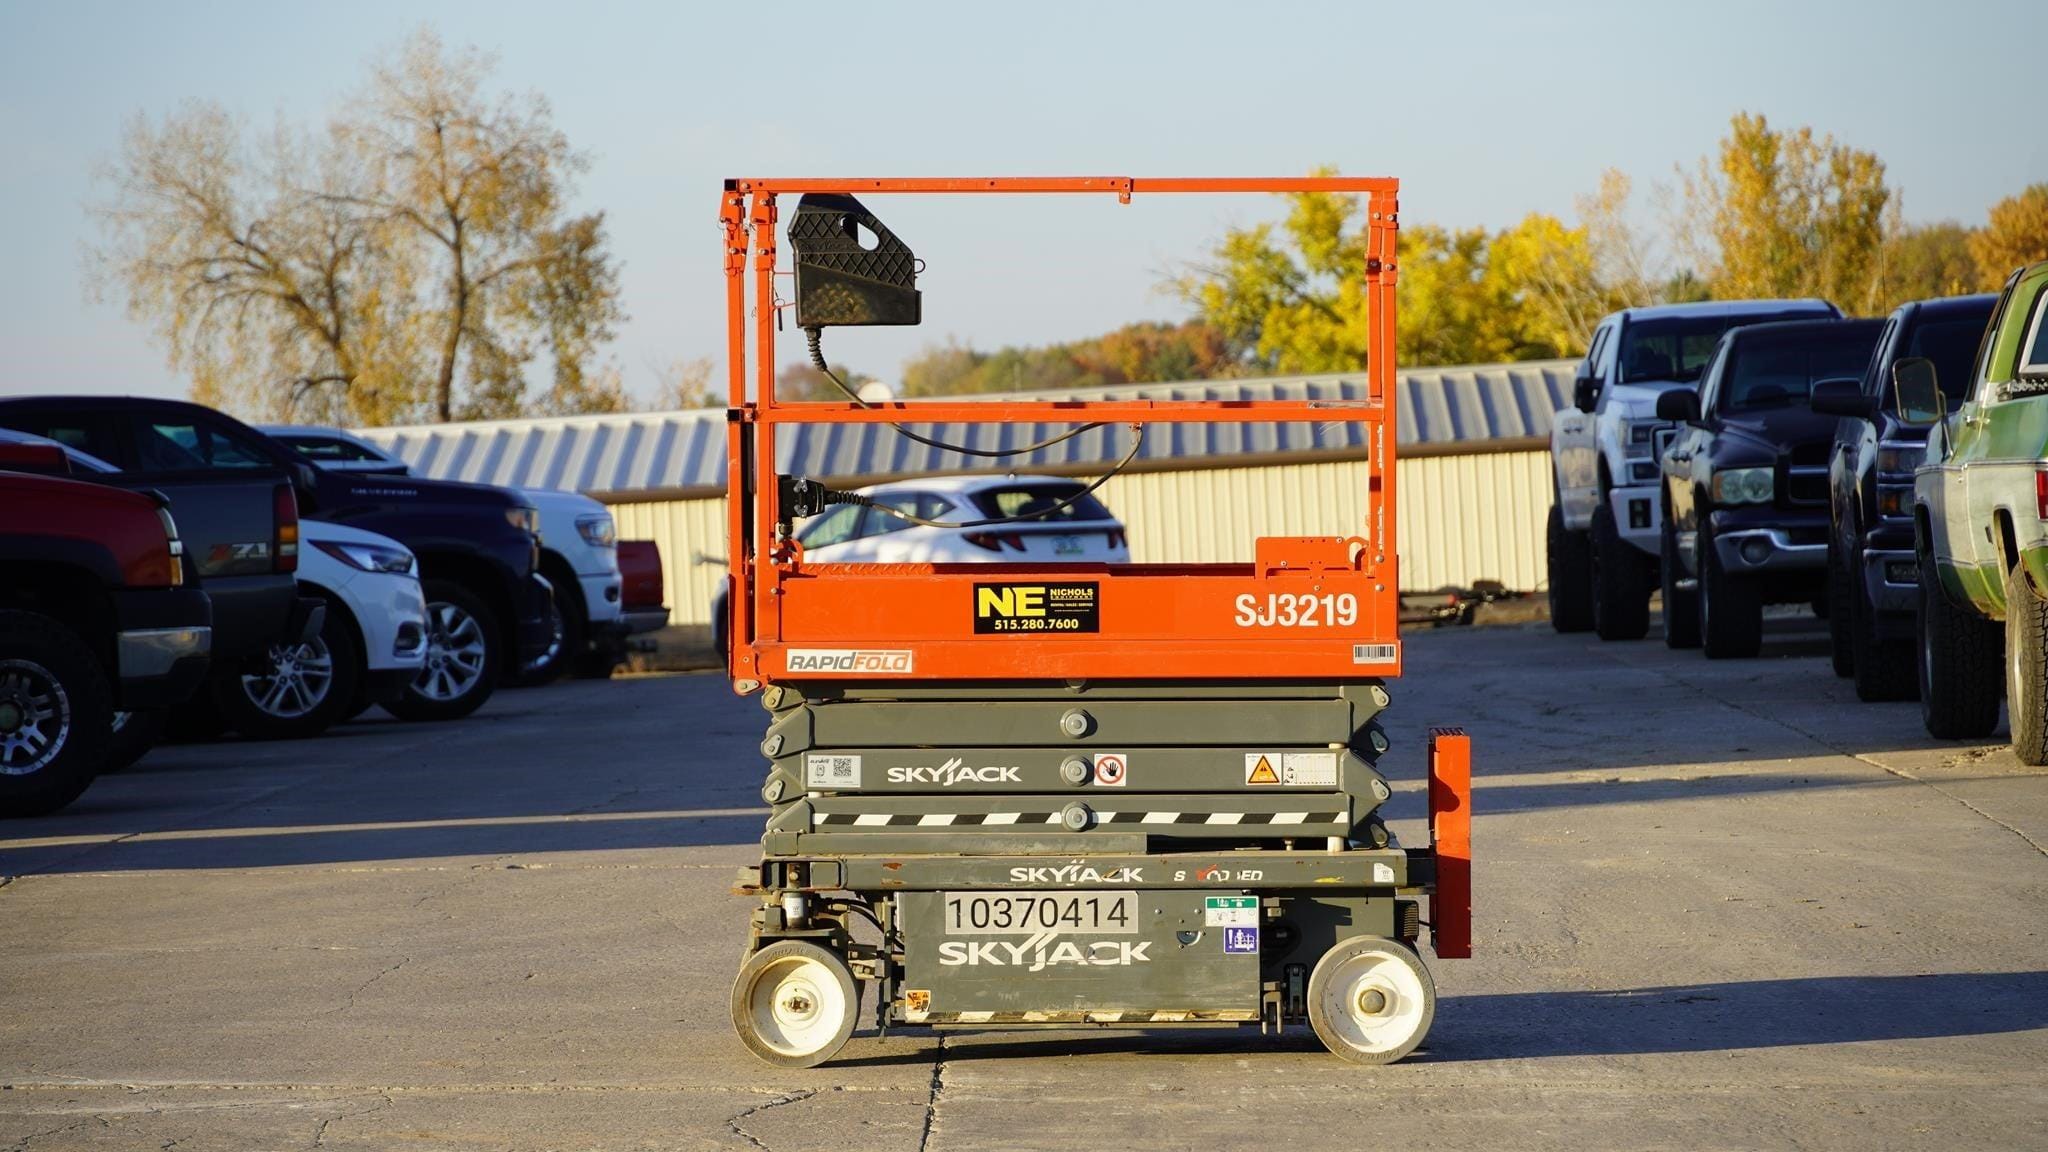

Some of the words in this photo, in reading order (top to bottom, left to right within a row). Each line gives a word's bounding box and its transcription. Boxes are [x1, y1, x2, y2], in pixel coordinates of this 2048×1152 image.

[978, 587, 1046, 617] NE
[1050, 588, 1093, 596] NICHOLS
[994, 619, 1079, 630] 515.280.7600
[1235, 593, 1358, 627] SJ3219
[887, 757, 1023, 786] SKYJACK
[949, 897, 1129, 929] 10370414
[938, 930, 1152, 972] SKYJACK
